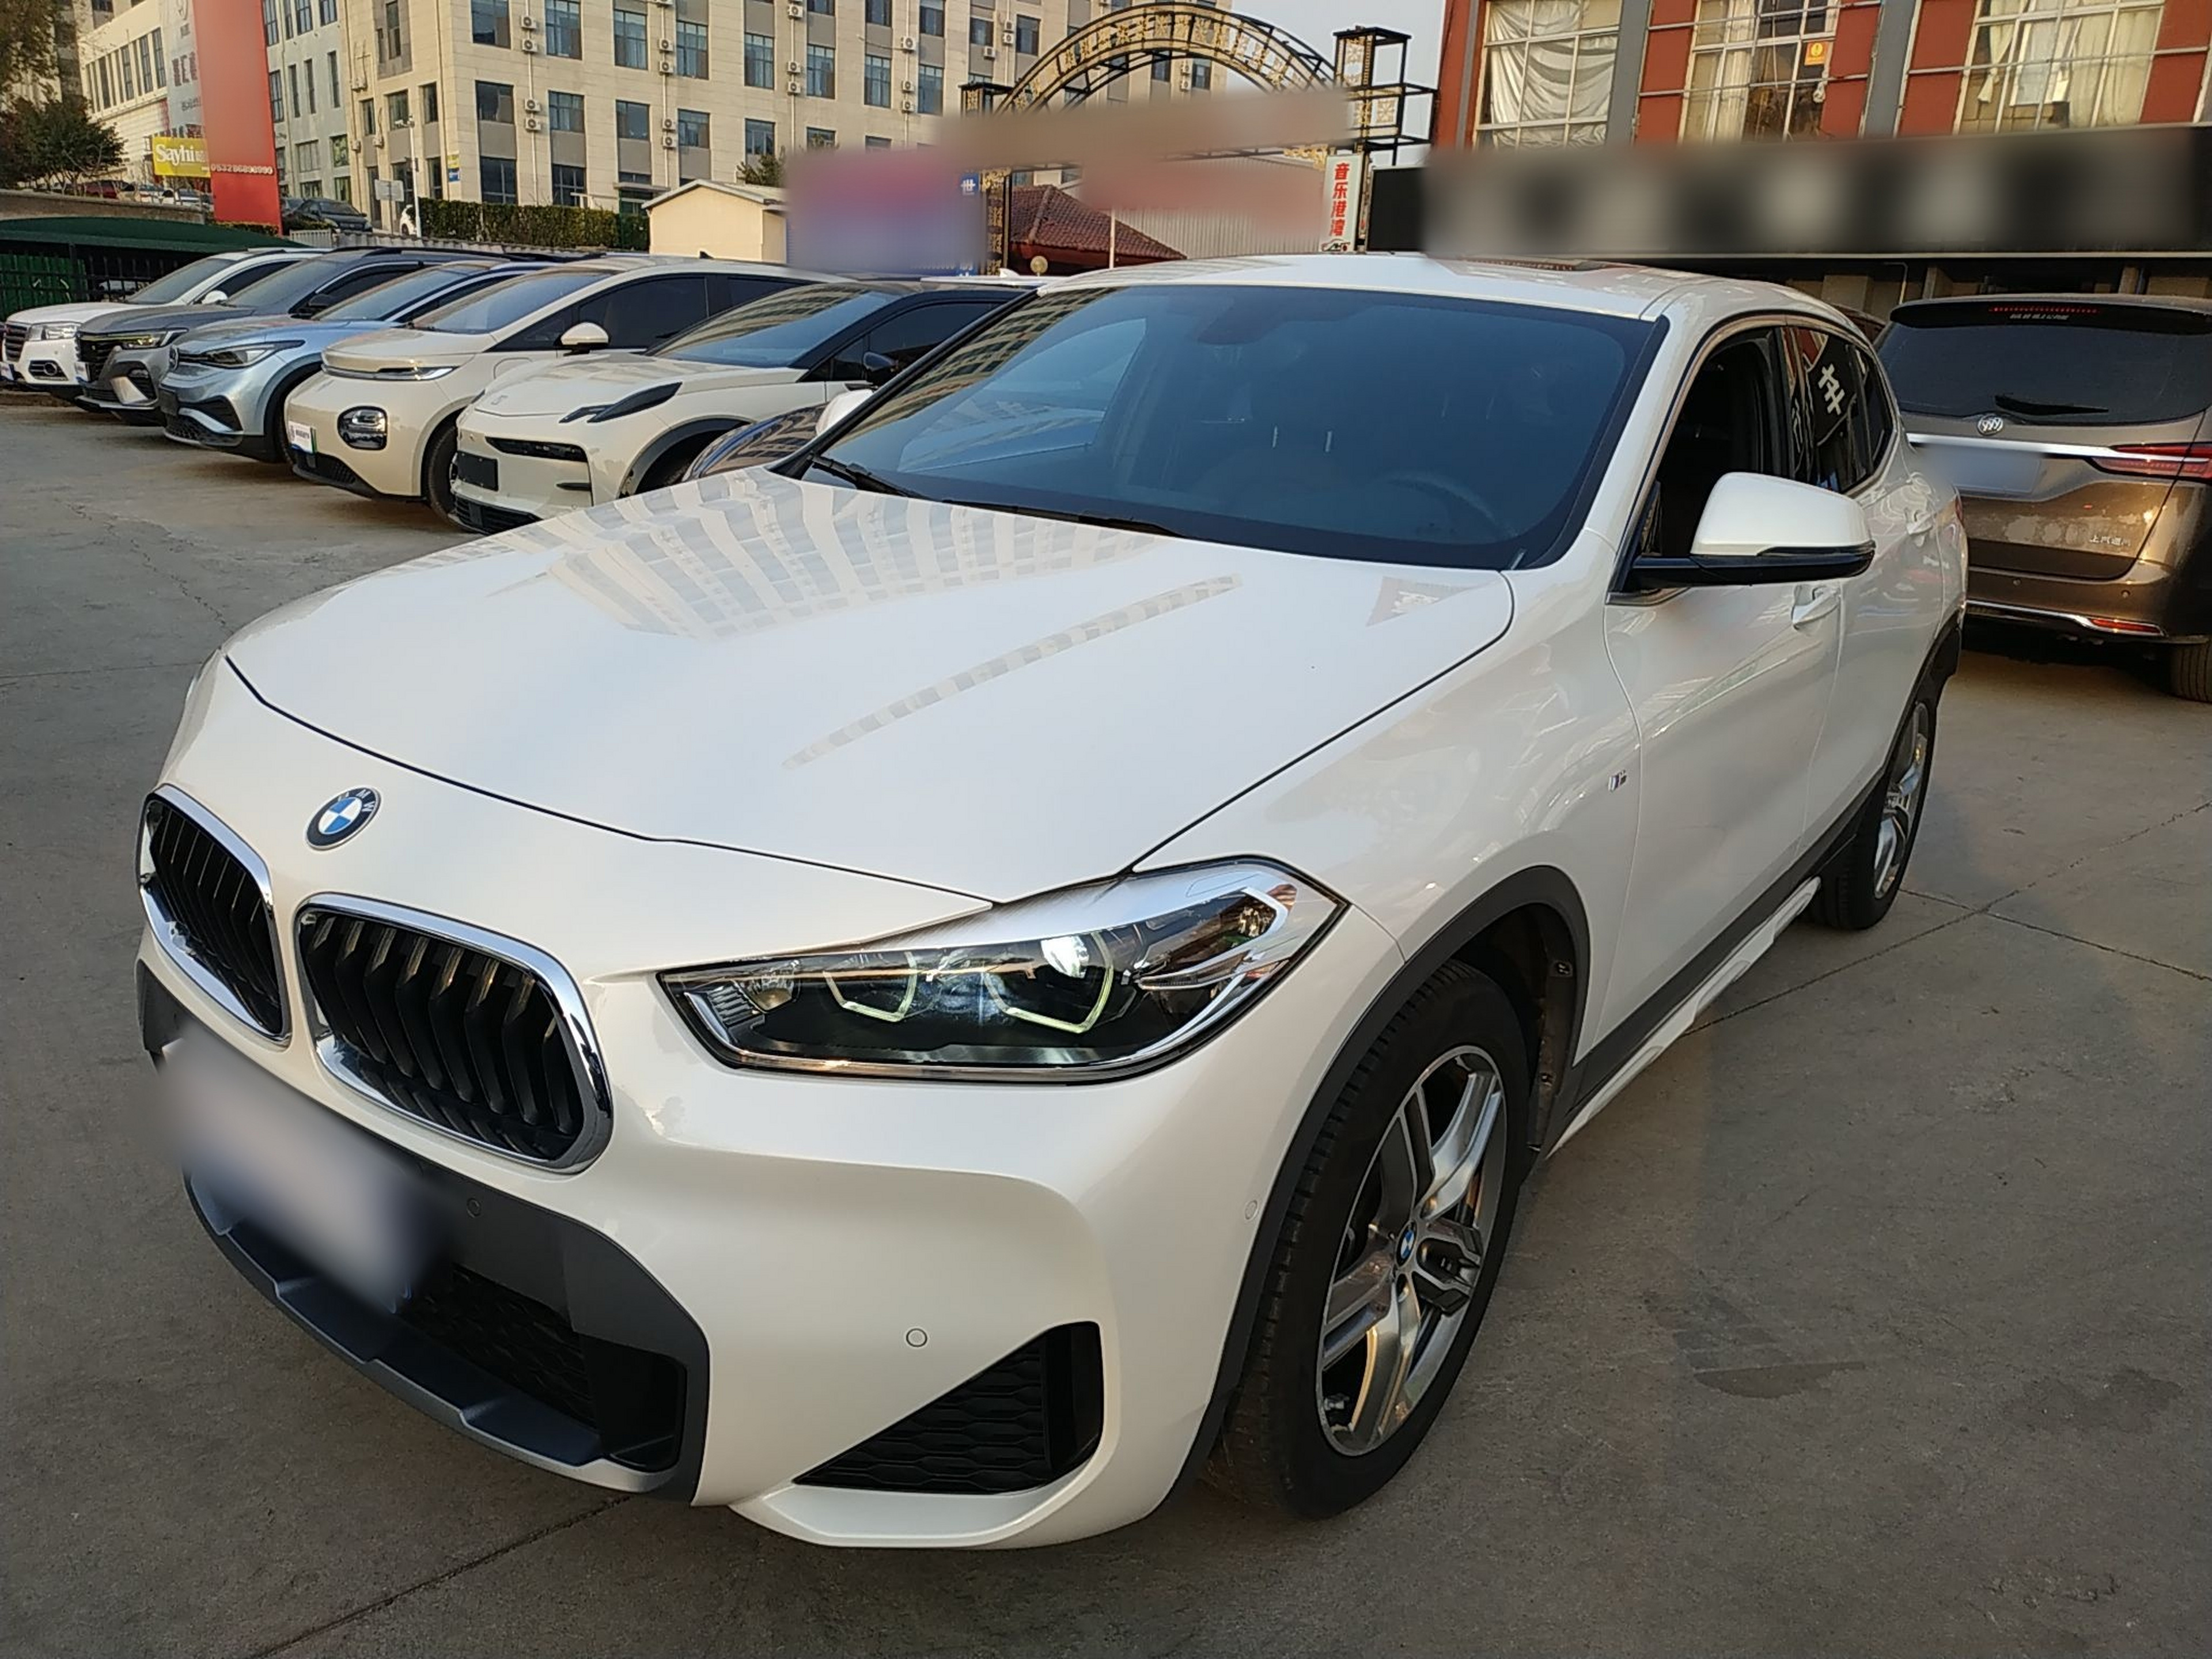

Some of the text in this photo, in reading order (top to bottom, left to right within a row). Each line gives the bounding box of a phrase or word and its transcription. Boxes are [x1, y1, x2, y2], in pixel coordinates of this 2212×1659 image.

[156, 143, 195, 166] Sayhi
[961, 179, 976, 195] 世
[1330, 162, 1350, 236] 音乐港湾
